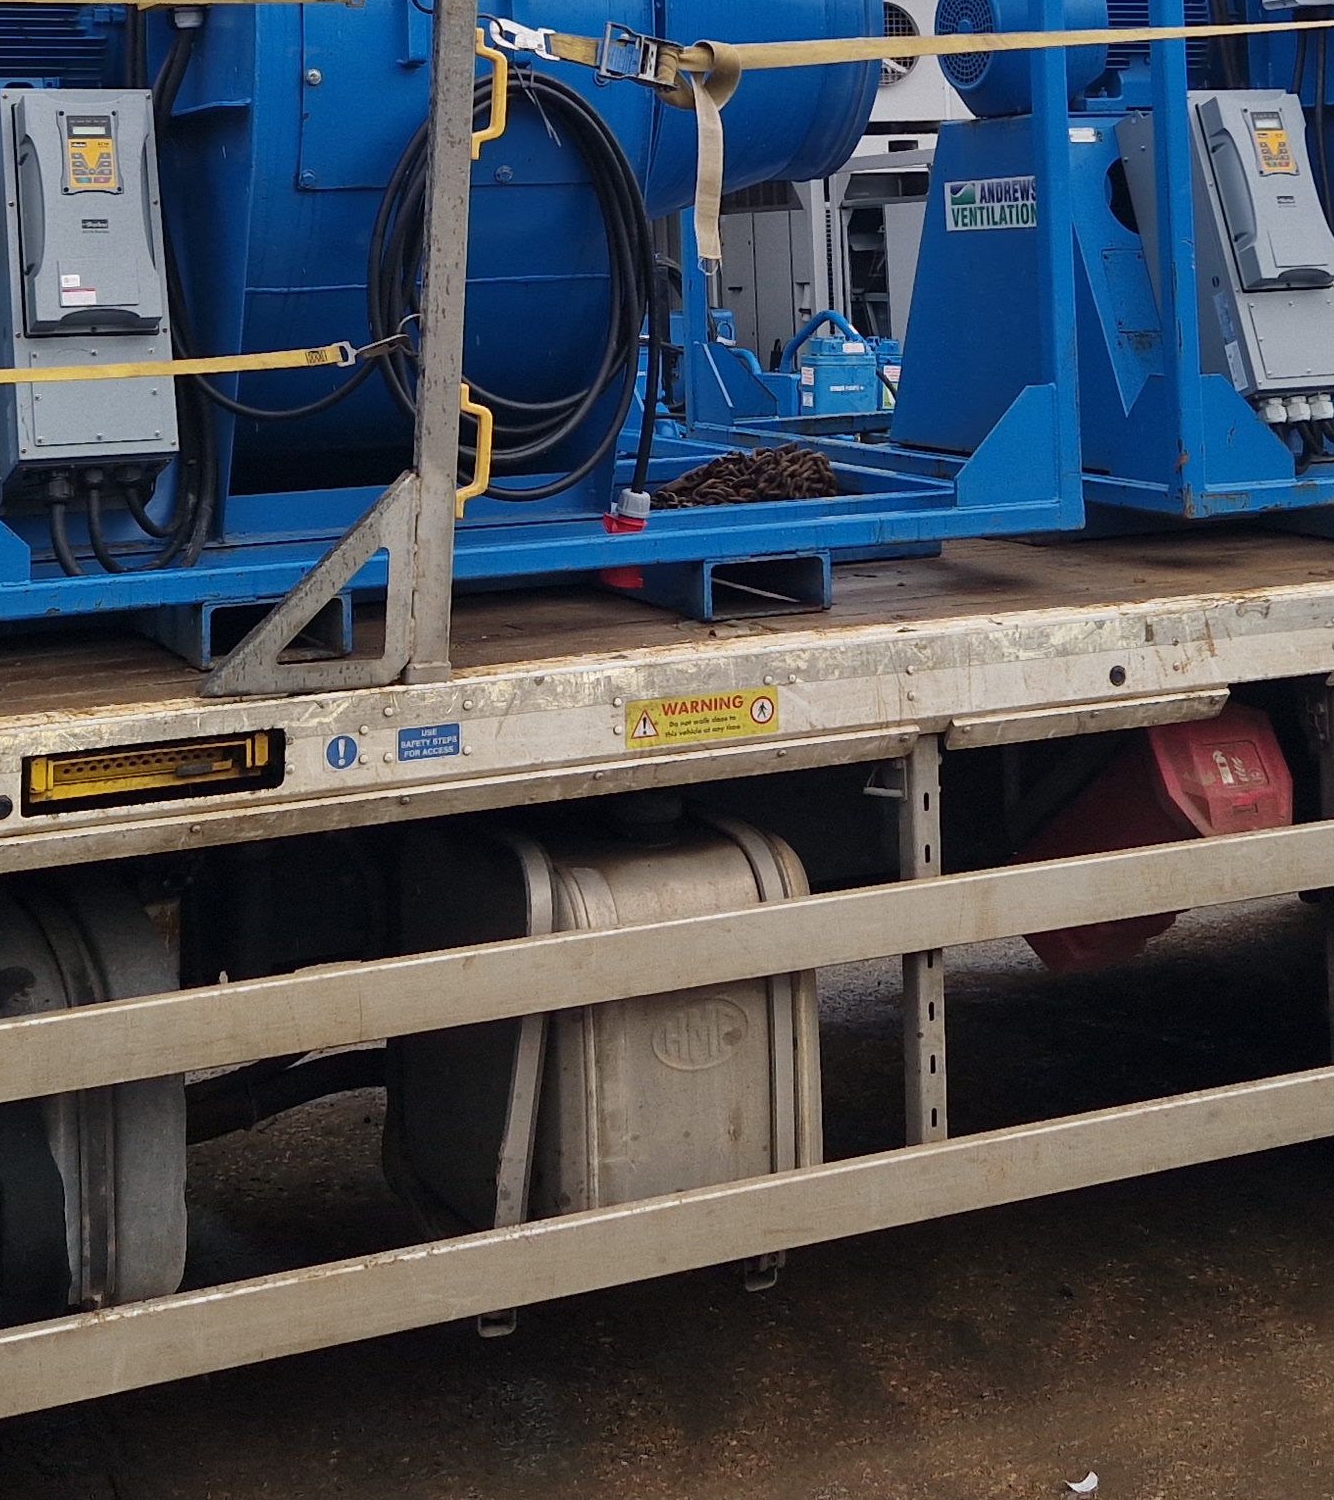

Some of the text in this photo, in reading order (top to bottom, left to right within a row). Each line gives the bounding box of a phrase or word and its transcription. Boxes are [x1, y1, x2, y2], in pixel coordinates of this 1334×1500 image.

[979, 177, 1036, 204] ANDREWS
[951, 203, 1037, 228] VENTILATION
[661, 695, 744, 716] WARNING
[693, 717, 709, 725] walk
[421, 728, 437, 736] USE
[679, 727, 701, 736] vehicle
[401, 735, 457, 748] SAFETY STEPS
[404, 745, 454, 758] FOR ACCESS
